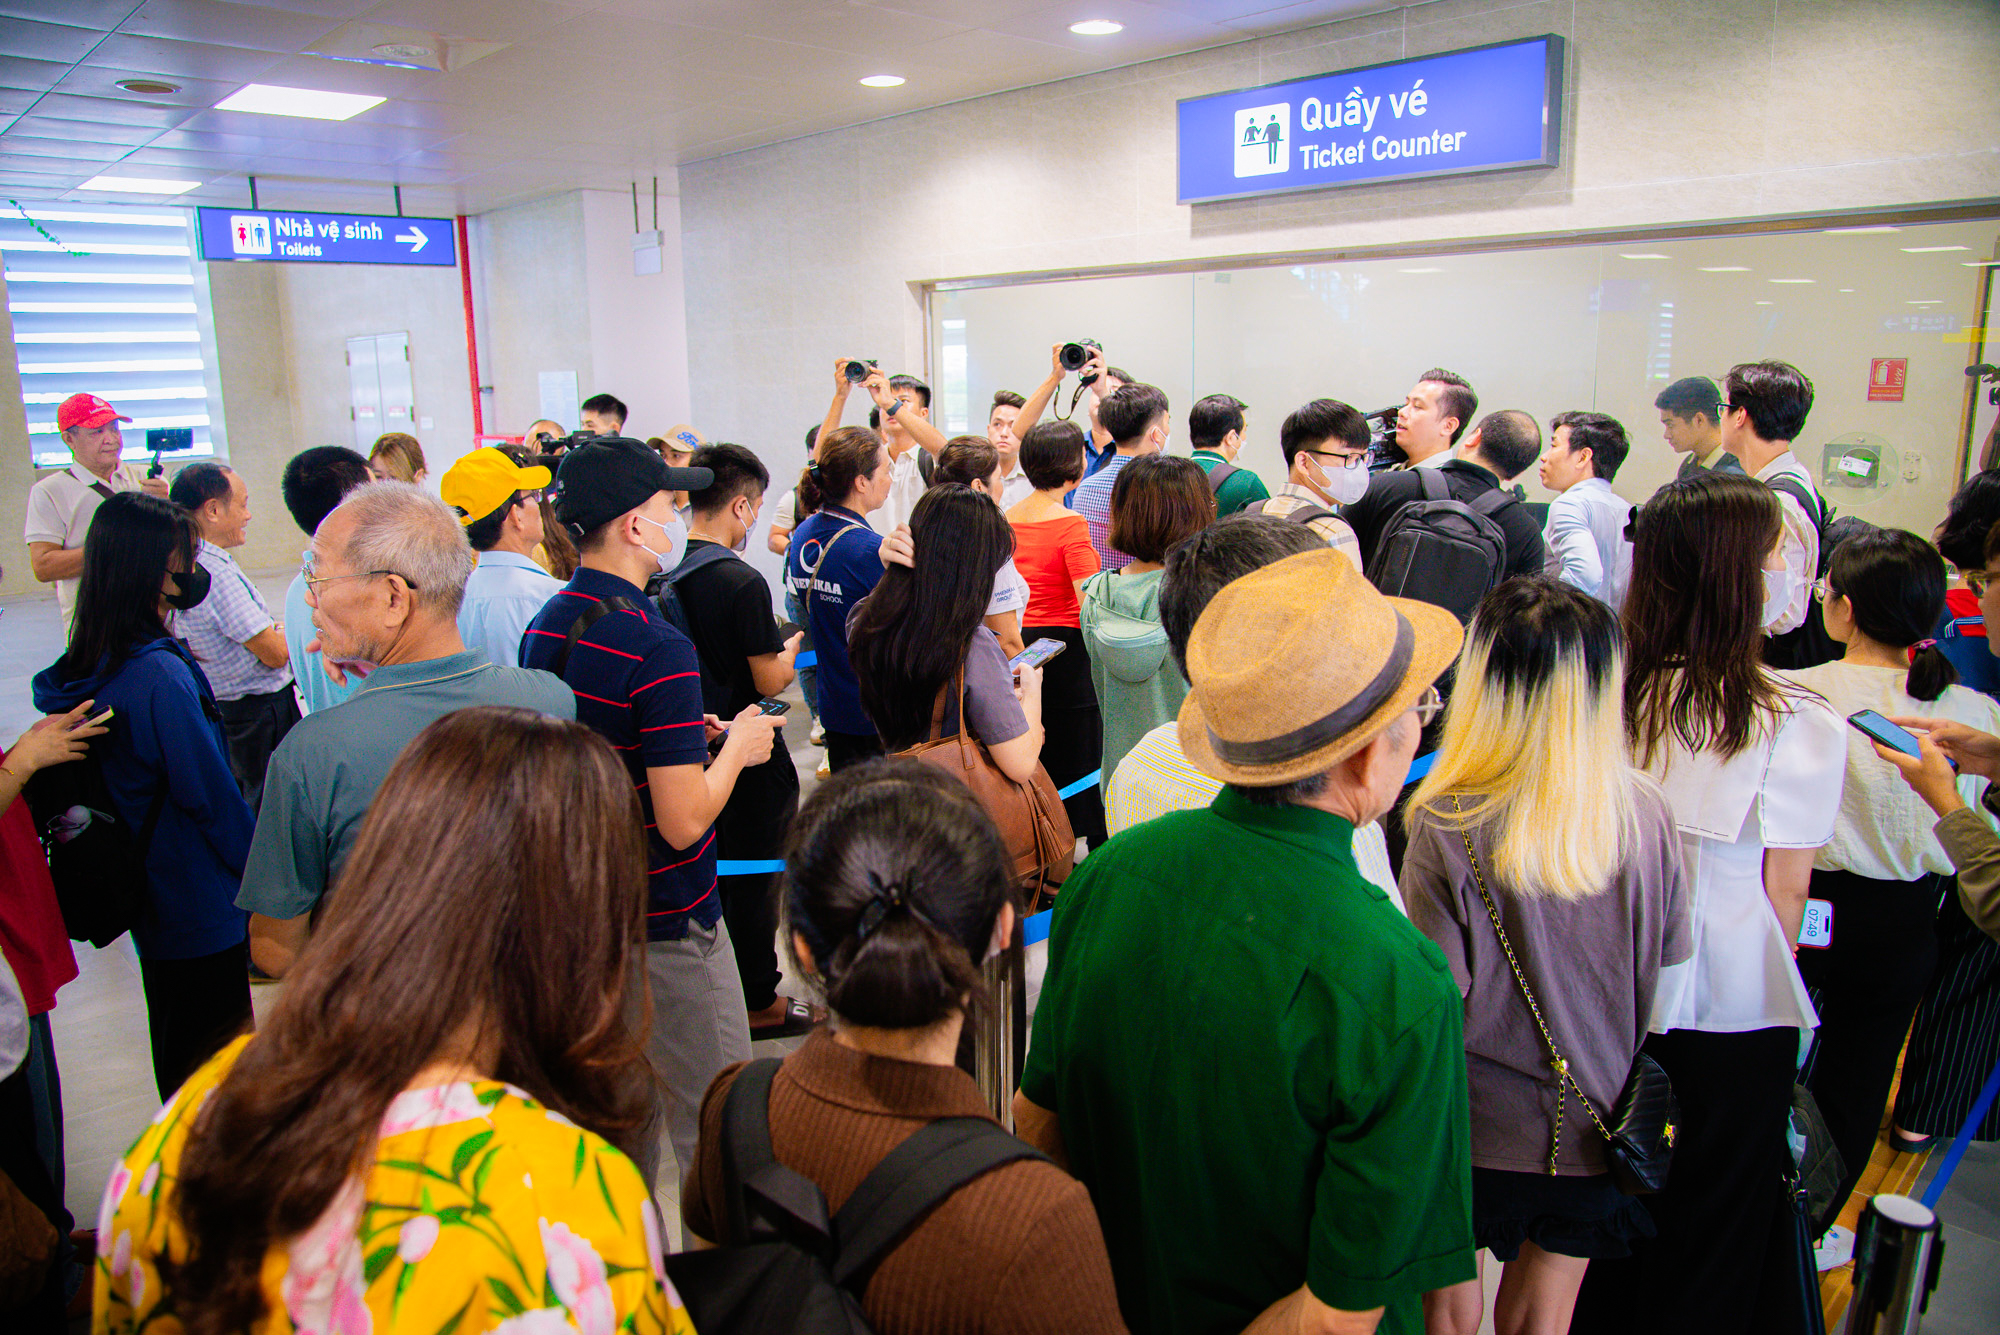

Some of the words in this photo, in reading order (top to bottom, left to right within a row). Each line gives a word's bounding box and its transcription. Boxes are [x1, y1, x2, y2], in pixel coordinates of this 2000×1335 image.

[1300, 86, 1381, 133] Quầy
[1388, 78, 1428, 117] vé
[1299, 139, 1366, 170] Ticket
[1371, 129, 1467, 161] Counter
[275, 217, 315, 238] Nhà
[317, 220, 340, 243] vệ
[344, 221, 383, 241] sinh
[277, 242, 323, 257] Toilets
[677, 431, 699, 450] For
[819, 593, 844, 605] SCHOOL
[1807, 908, 1819, 937] 07:49
